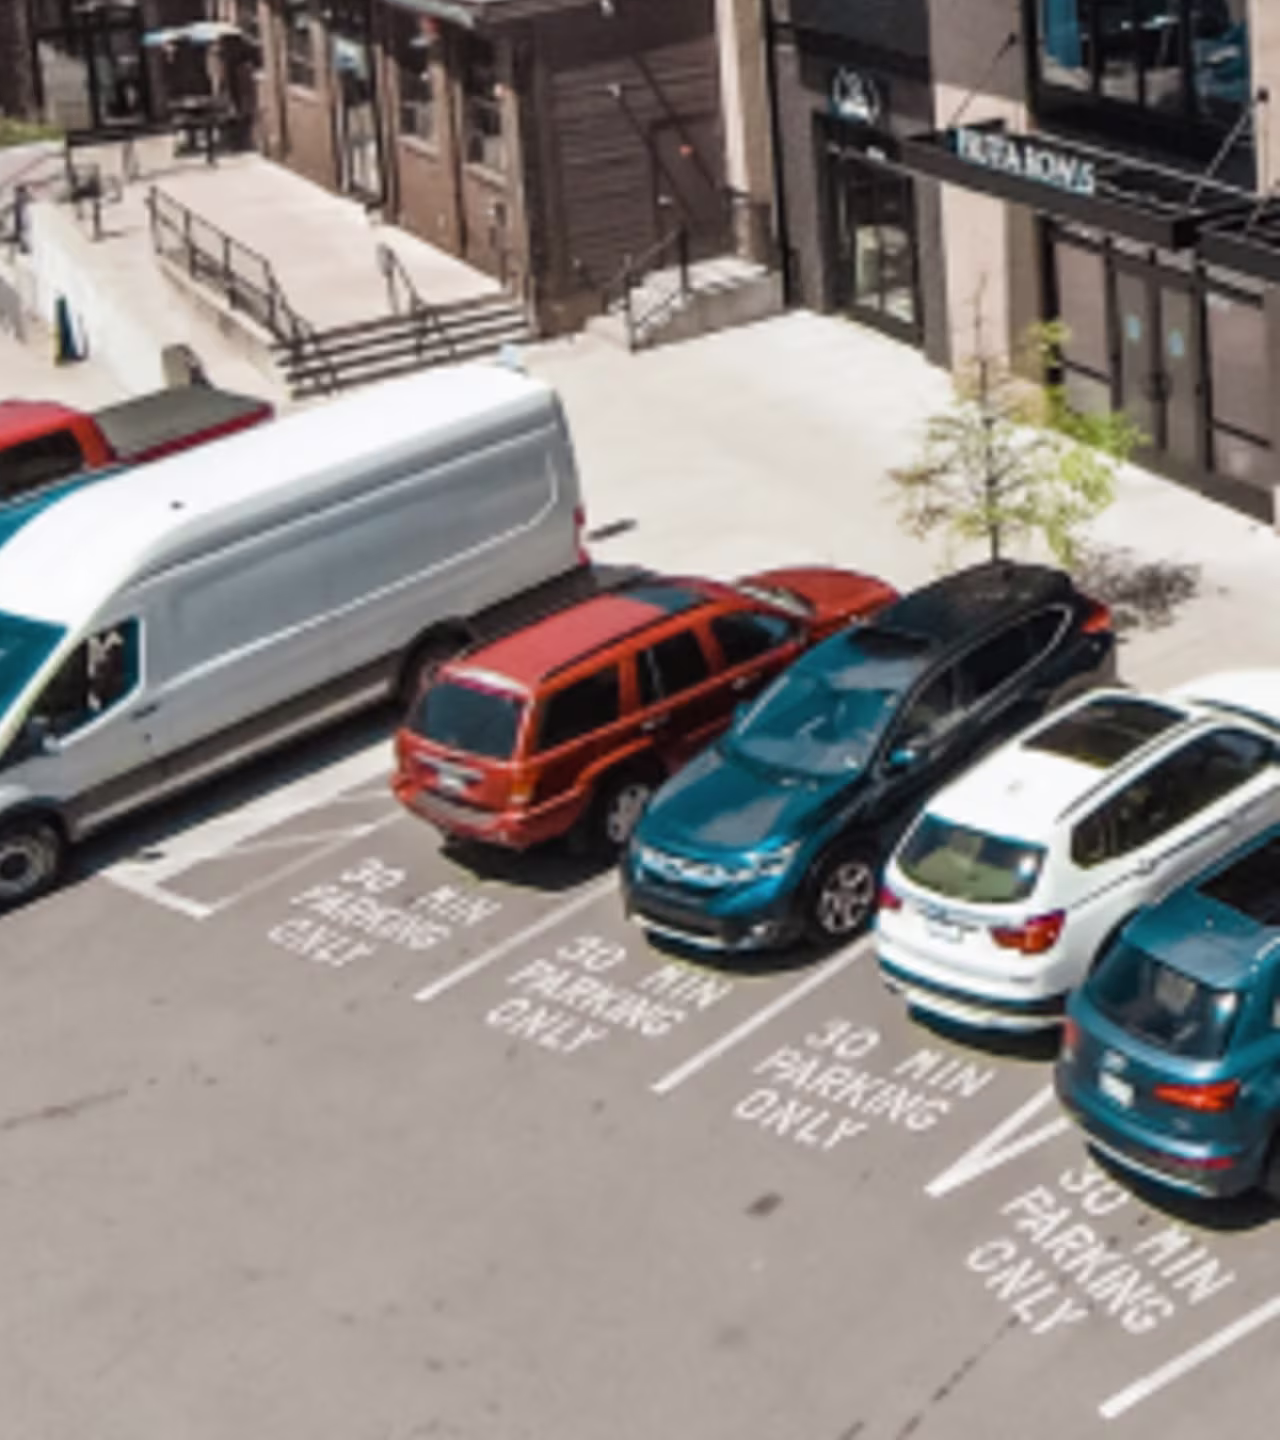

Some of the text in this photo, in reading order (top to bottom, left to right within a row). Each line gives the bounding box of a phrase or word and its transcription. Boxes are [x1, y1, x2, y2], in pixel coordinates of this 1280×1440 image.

[290, 885, 451, 950] PARKING
[409, 886, 503, 927] MIN
[268, 919, 378, 967] ONLY
[506, 959, 686, 1035] PARKING
[637, 964, 734, 1010] MIN
[485, 998, 609, 1052] ONLY
[754, 1046, 951, 1132] PARKING
[895, 1049, 996, 1098] MIN
[734, 1087, 869, 1152] ONLY
[964, 1241, 1088, 1335] ONLY
[1000, 1185, 1175, 1335] PARKING
[1135, 1222, 1237, 1306] MIN
